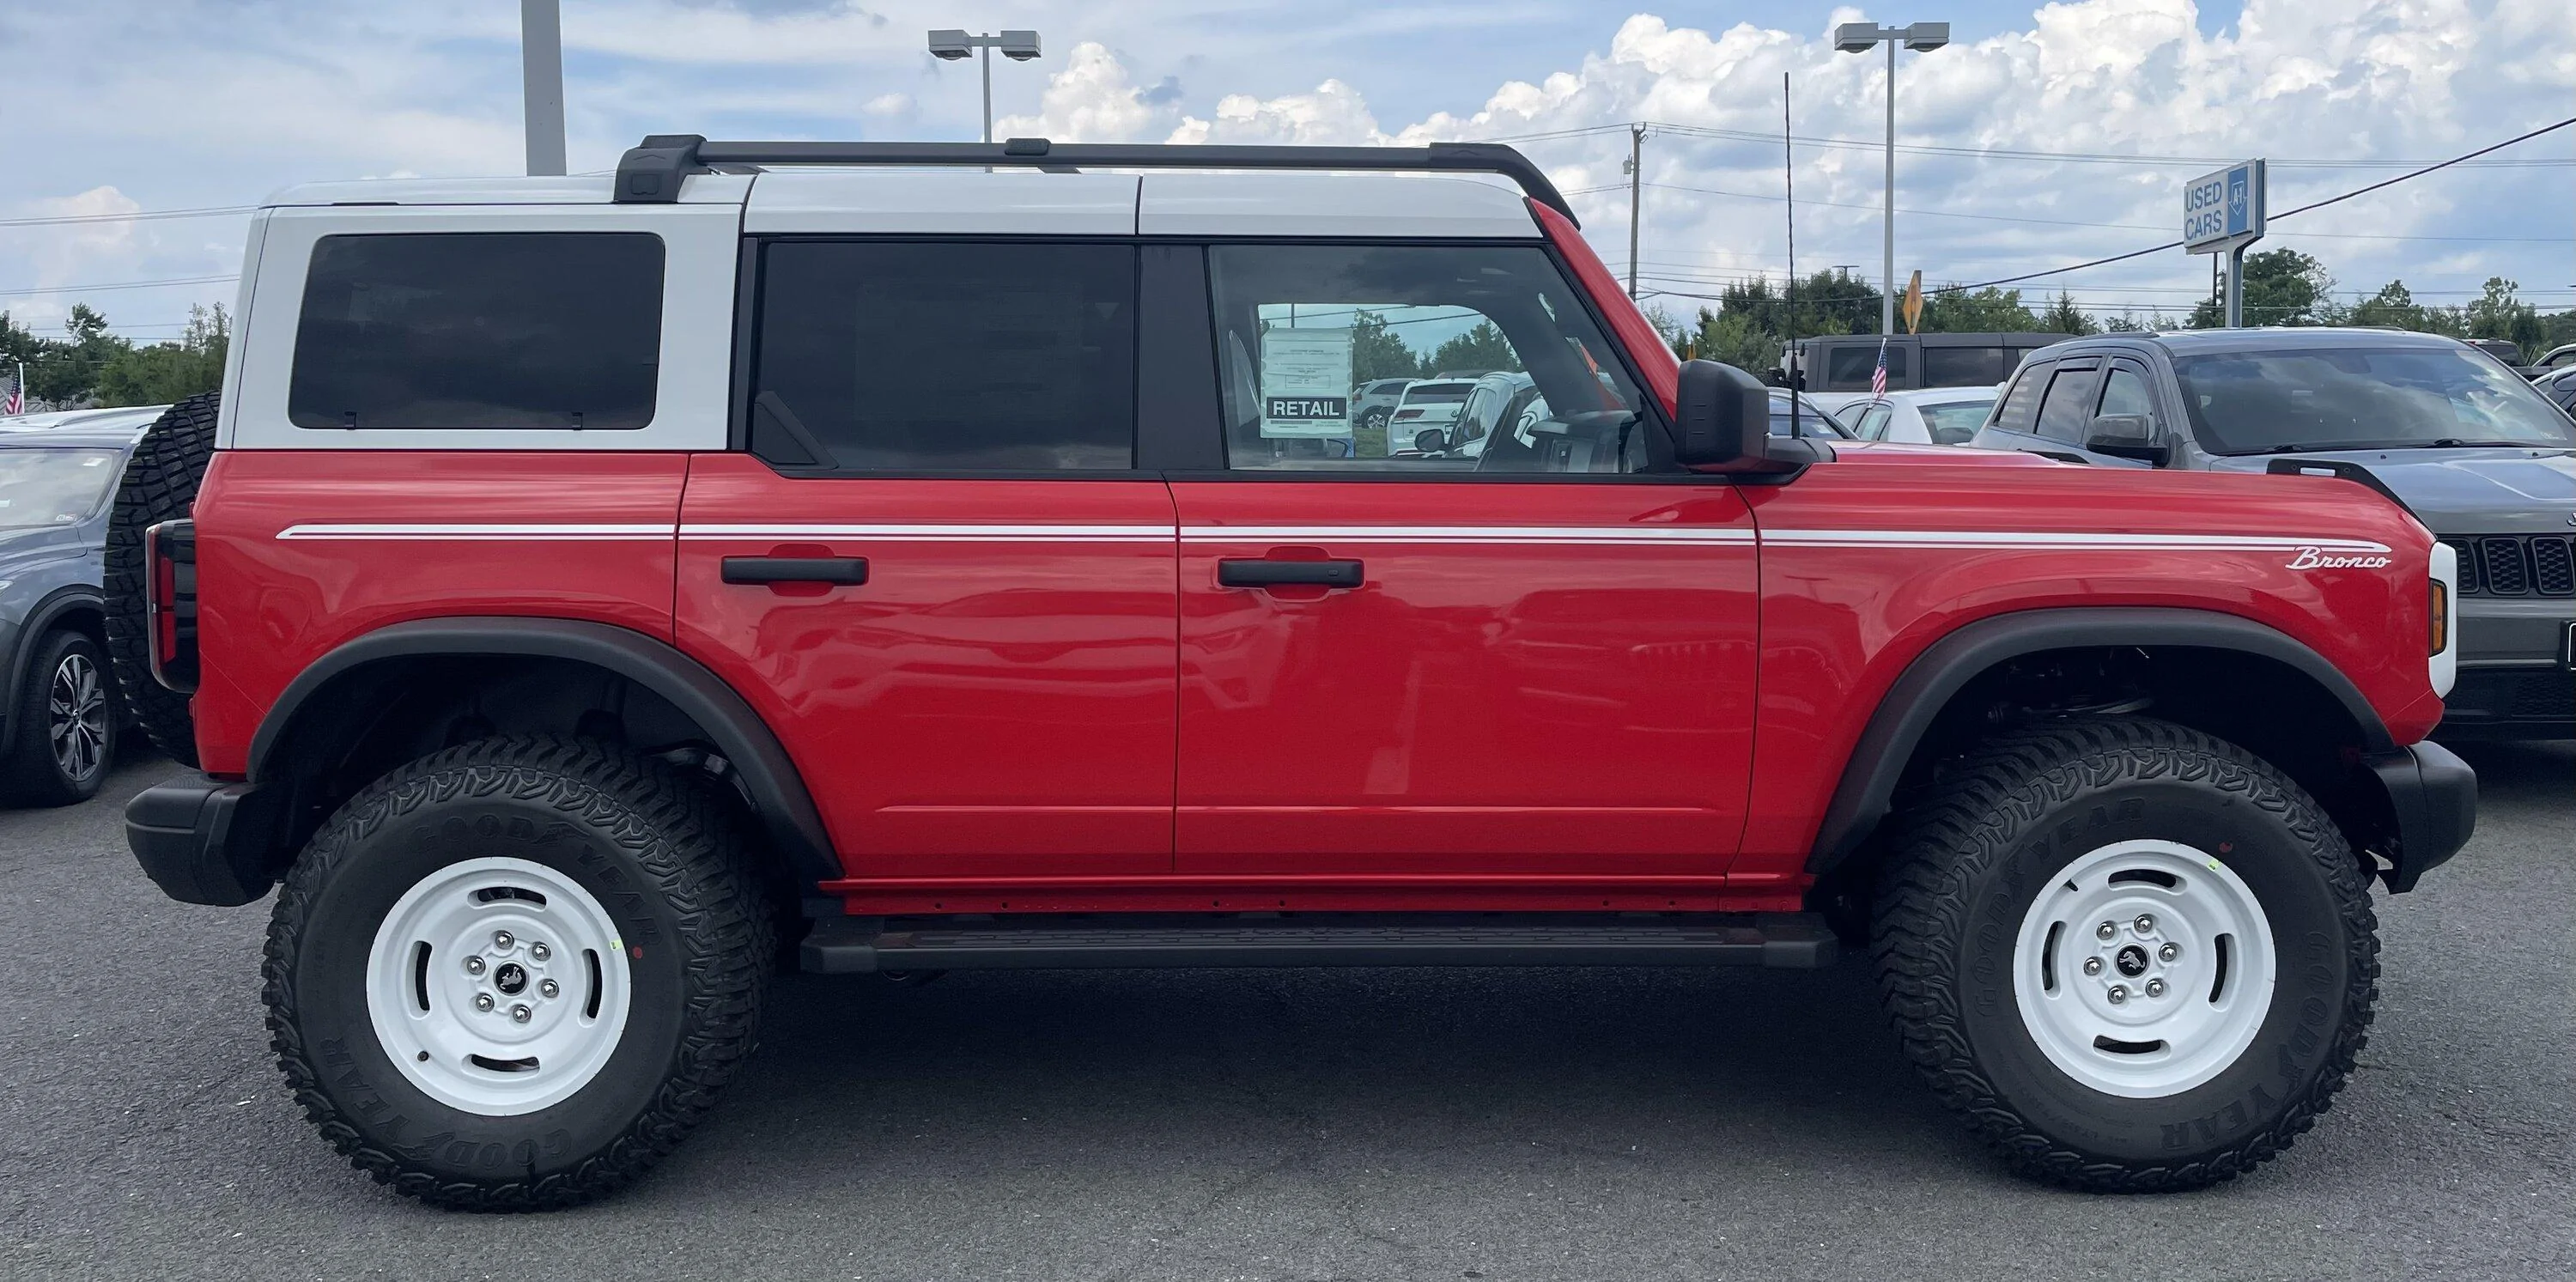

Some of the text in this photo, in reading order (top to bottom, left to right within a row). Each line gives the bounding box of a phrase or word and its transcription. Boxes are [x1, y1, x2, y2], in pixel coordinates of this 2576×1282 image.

[2186, 181, 2222, 212] USED
[2185, 210, 2222, 240] CARS
[1273, 401, 1340, 416] RETAIL
[2285, 545, 2392, 570] Bronco
